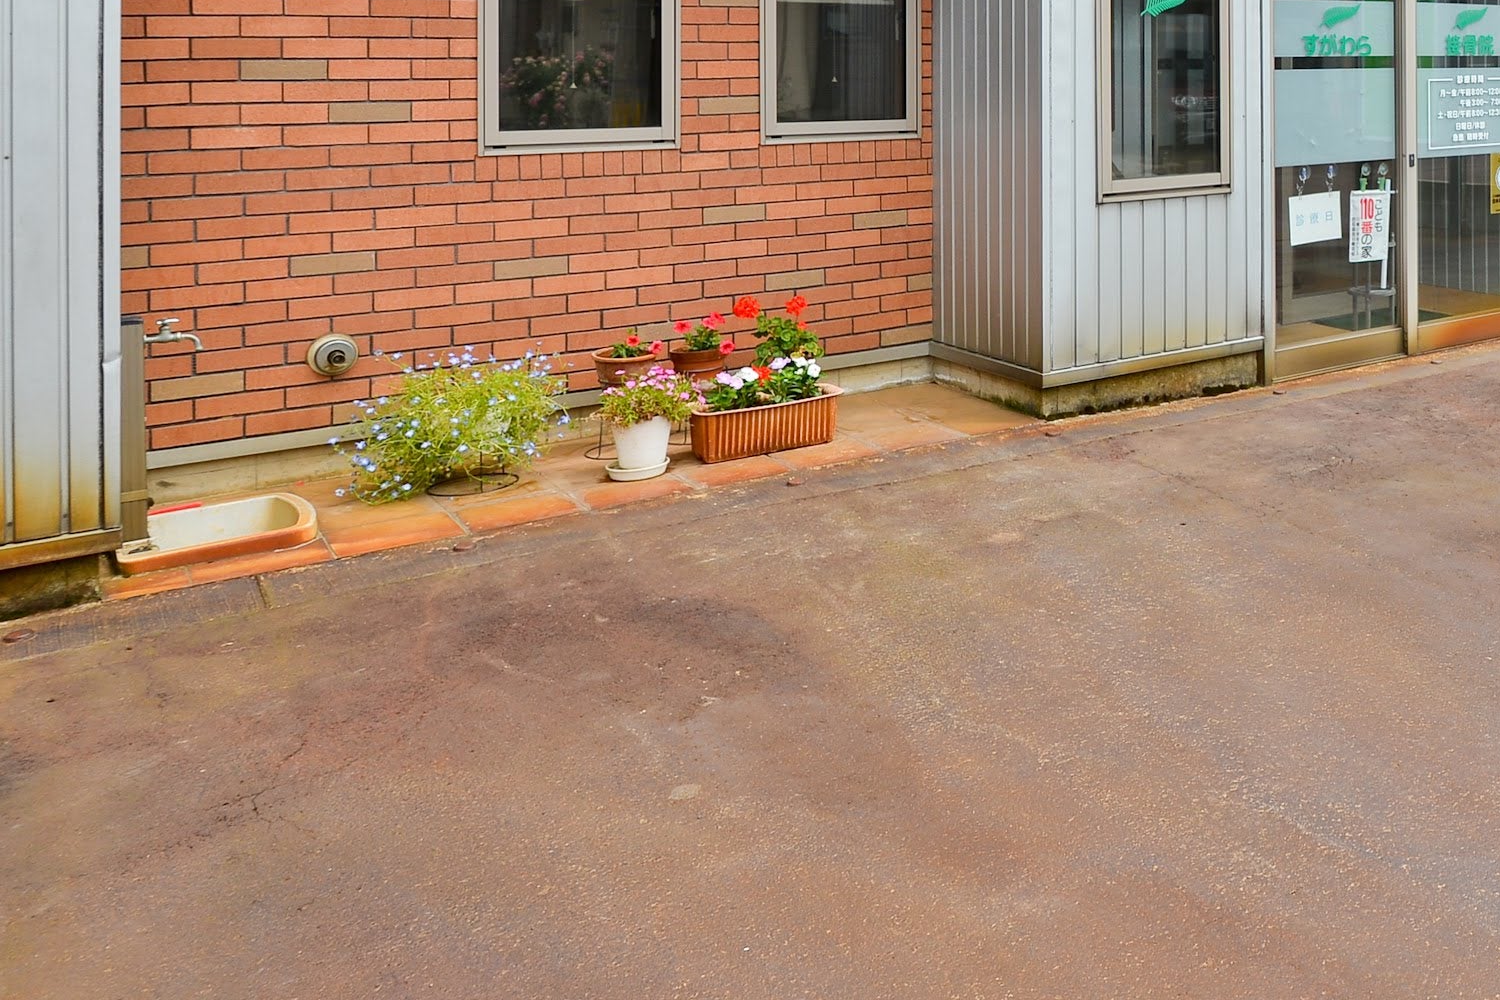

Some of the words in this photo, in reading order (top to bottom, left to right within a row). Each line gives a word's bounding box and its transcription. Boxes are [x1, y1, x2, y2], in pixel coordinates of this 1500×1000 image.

[1301, 33, 1372, 56] すがわら
[1445, 34, 1495, 56] 接骨院
[1360, 197, 1374, 259] 110番の家
[1374, 199, 1383, 233] こども
